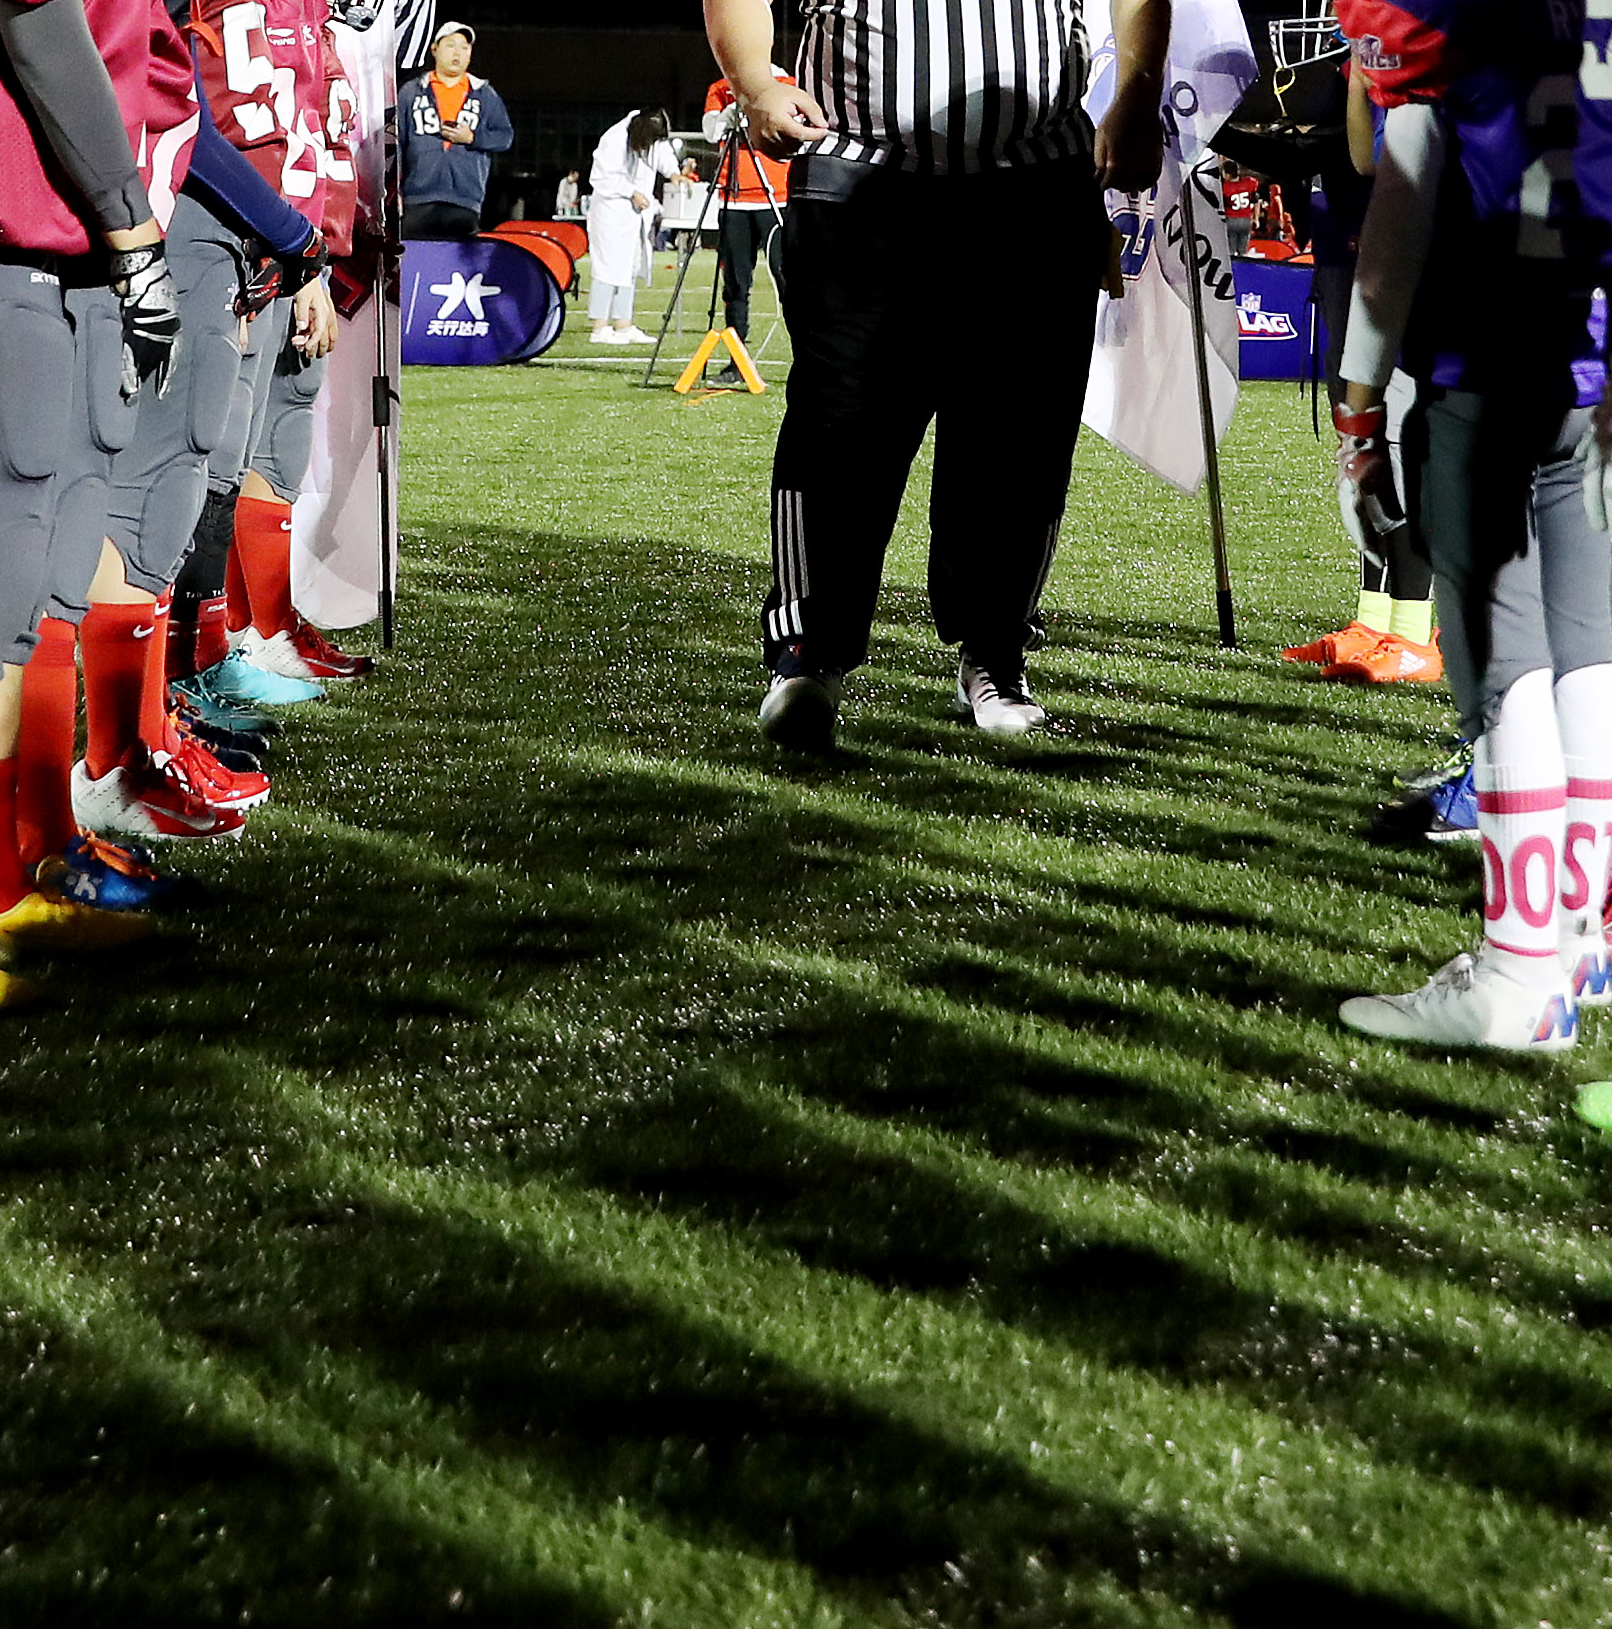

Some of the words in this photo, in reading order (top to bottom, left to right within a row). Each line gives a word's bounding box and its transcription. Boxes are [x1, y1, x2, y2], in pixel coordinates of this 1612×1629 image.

[1230, 192, 1251, 211] 35
[426, 319, 490, 338] 天行达阵
